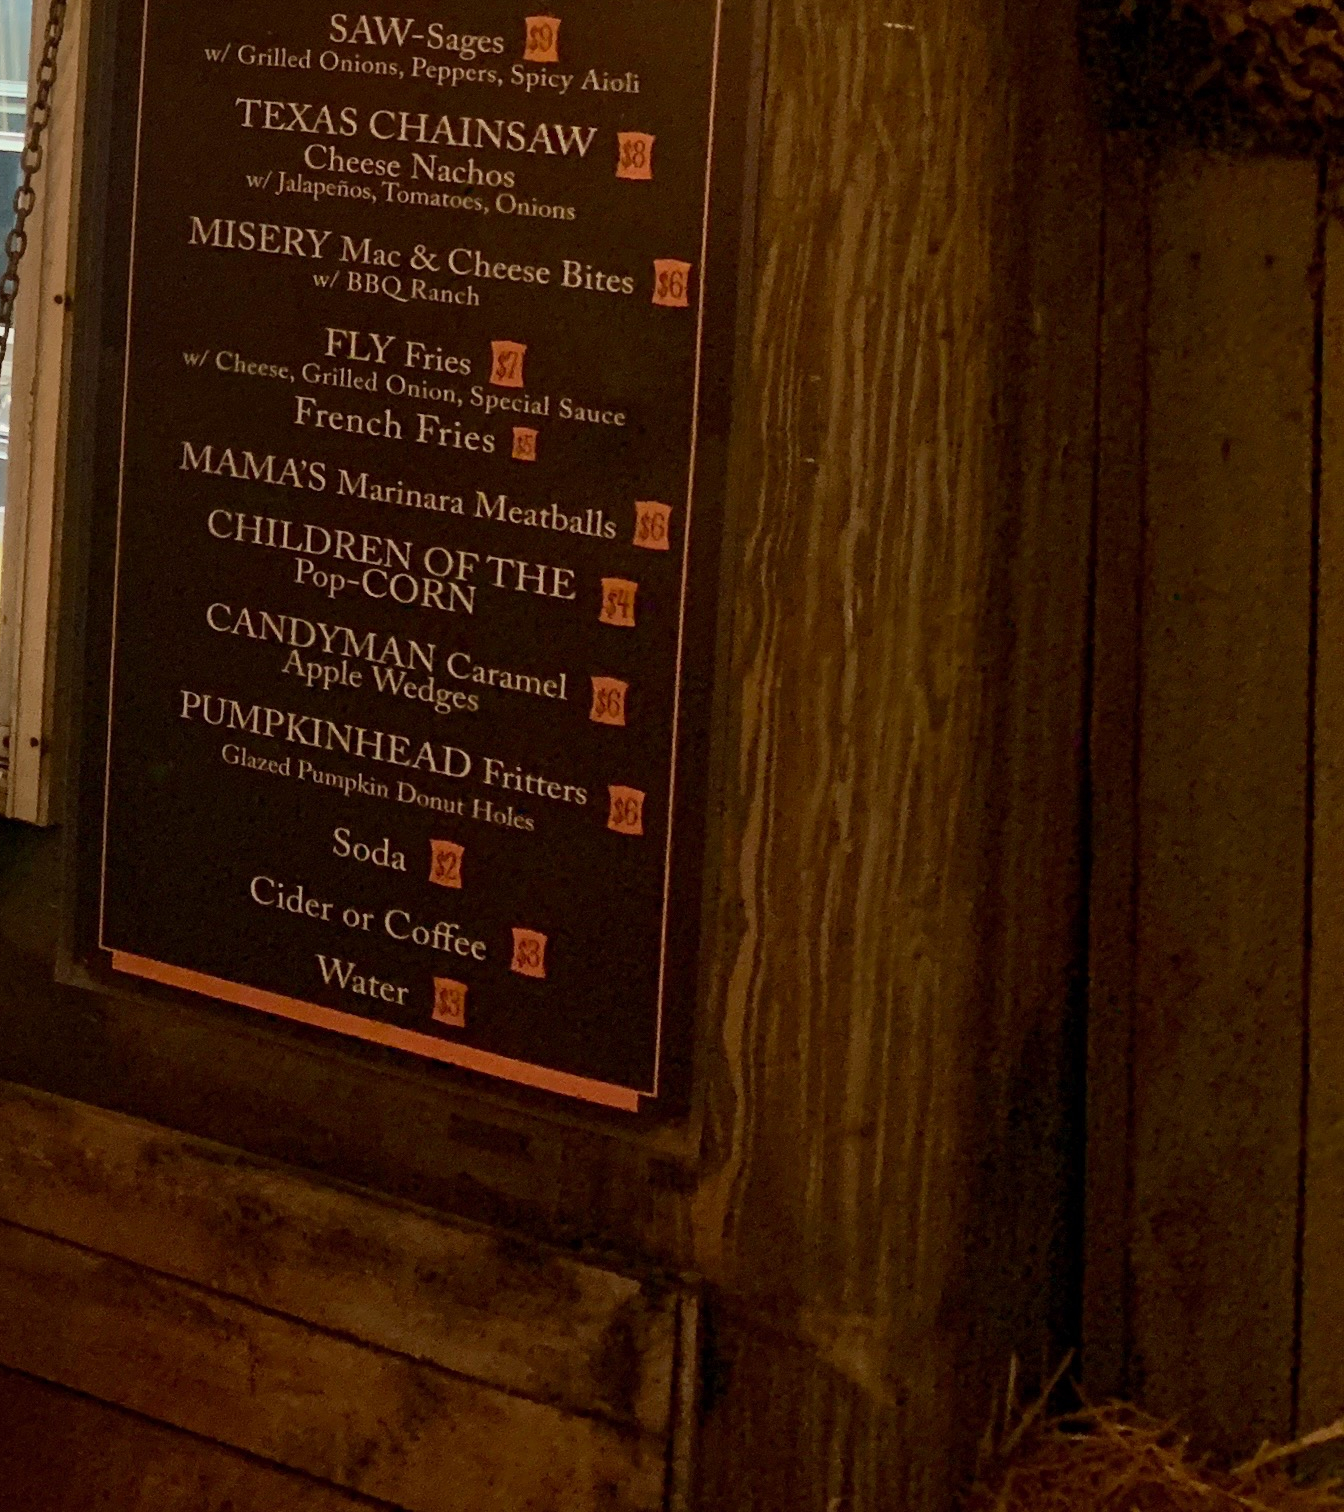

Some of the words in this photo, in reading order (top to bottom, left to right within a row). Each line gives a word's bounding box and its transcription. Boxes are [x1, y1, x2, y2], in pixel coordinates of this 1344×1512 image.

[329, 13, 505, 54] SAW-Sages
[205, 43, 231, 63] w/
[238, 44, 311, 69] Grilled
[319, 50, 404, 79] Onions,
[411, 57, 503, 88] Peppers,
[511, 65, 573, 94] Spicy
[582, 69, 640, 93] Aioli
[235, 97, 358, 136] TEXAS
[369, 110, 597, 157] CHAINSAW
[246, 170, 272, 189] w/
[275, 171, 375, 203] Jalapeños,
[381, 182, 489, 213] Tomatoes,
[496, 194, 575, 220] Onions
[304, 145, 400, 178] Cheese
[411, 153, 515, 188] Nachos
[188, 215, 332, 261] MISERY
[339, 235, 401, 269] Mac
[410, 243, 439, 272] &
[448, 248, 550, 285] Cheese
[561, 260, 634, 295] Bites
[313, 269, 339, 289] w/
[346, 272, 406, 301] BBQ
[411, 278, 480, 307] Ranch
[325, 328, 395, 363] FLY
[406, 340, 471, 375] Fries
[183, 348, 209, 367] w/
[215, 349, 295, 383] Cheese,
[302, 360, 377, 392] Grilled
[385, 372, 463, 406] Onion,
[470, 385, 549, 416] Special
[559, 397, 625, 427] Sauce
[295, 396, 403, 440] French
[416, 411, 496, 449] Fries
[337, 468, 465, 516] Marinara
[474, 489, 617, 539] Meatballs
[207, 508, 412, 570] CHILDREN
[424, 548, 478, 581] OF
[485, 555, 576, 601] THE
[295, 557, 477, 615] Pop-CORN
[206, 603, 436, 672] CANDYMAN
[447, 653, 567, 700] Caramel
[282, 650, 363, 689] Apple
[372, 665, 479, 716] Wedges
[180, 689, 472, 778] PUMPKINHEAD
[482, 757, 588, 806] Fritters
[221, 743, 292, 778] Glazed
[297, 760, 389, 800] Pumpkin
[397, 781, 465, 816] Donut
[472, 798, 535, 831] Holes
[332, 827, 407, 871] Soda
[250, 875, 333, 921] Cider
[343, 907, 374, 931] or
[385, 909, 486, 962] Coffee
[315, 953, 410, 1005] Water
